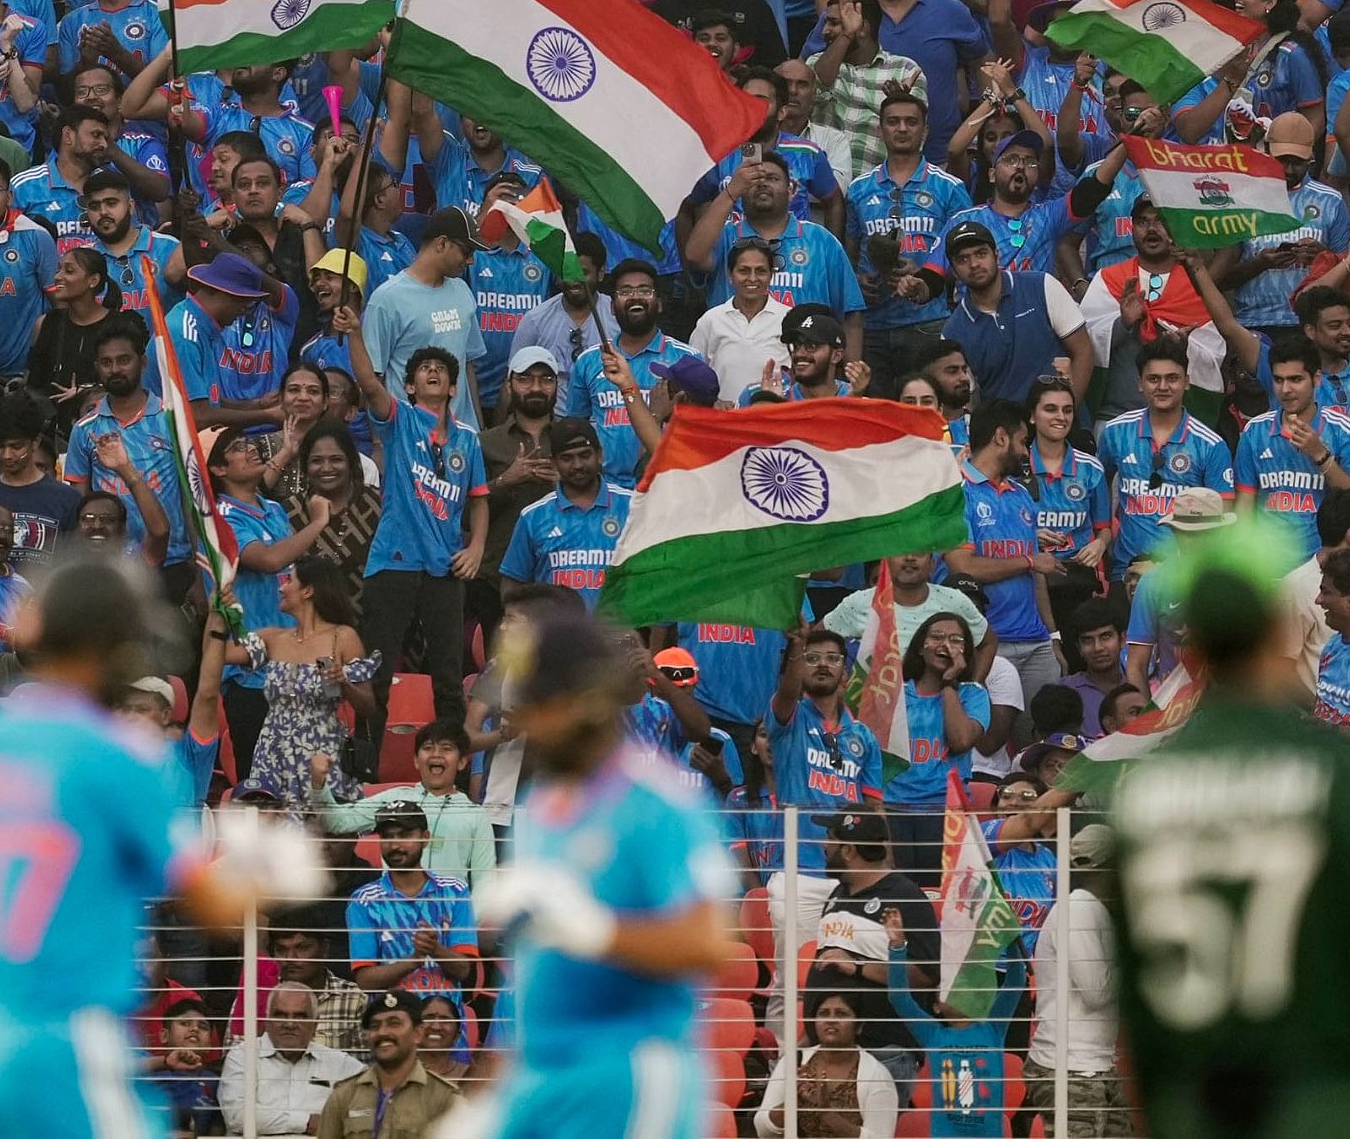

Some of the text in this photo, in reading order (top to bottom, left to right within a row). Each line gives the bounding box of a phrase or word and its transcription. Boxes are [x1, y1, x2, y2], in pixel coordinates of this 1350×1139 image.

[1149, 141, 1246, 171] bharat
[1194, 214, 1256, 236] army
[477, 293, 541, 307] DREAM11
[1259, 472, 1325, 488] DREAM11
[1126, 495, 1175, 515] INDIA
[1268, 492, 1316, 511] INDIA
[984, 539, 1034, 557] INDIA
[553, 572, 606, 589] INDIA
[698, 623, 754, 643] INDIA
[1126, 845, 1325, 1028] 57
